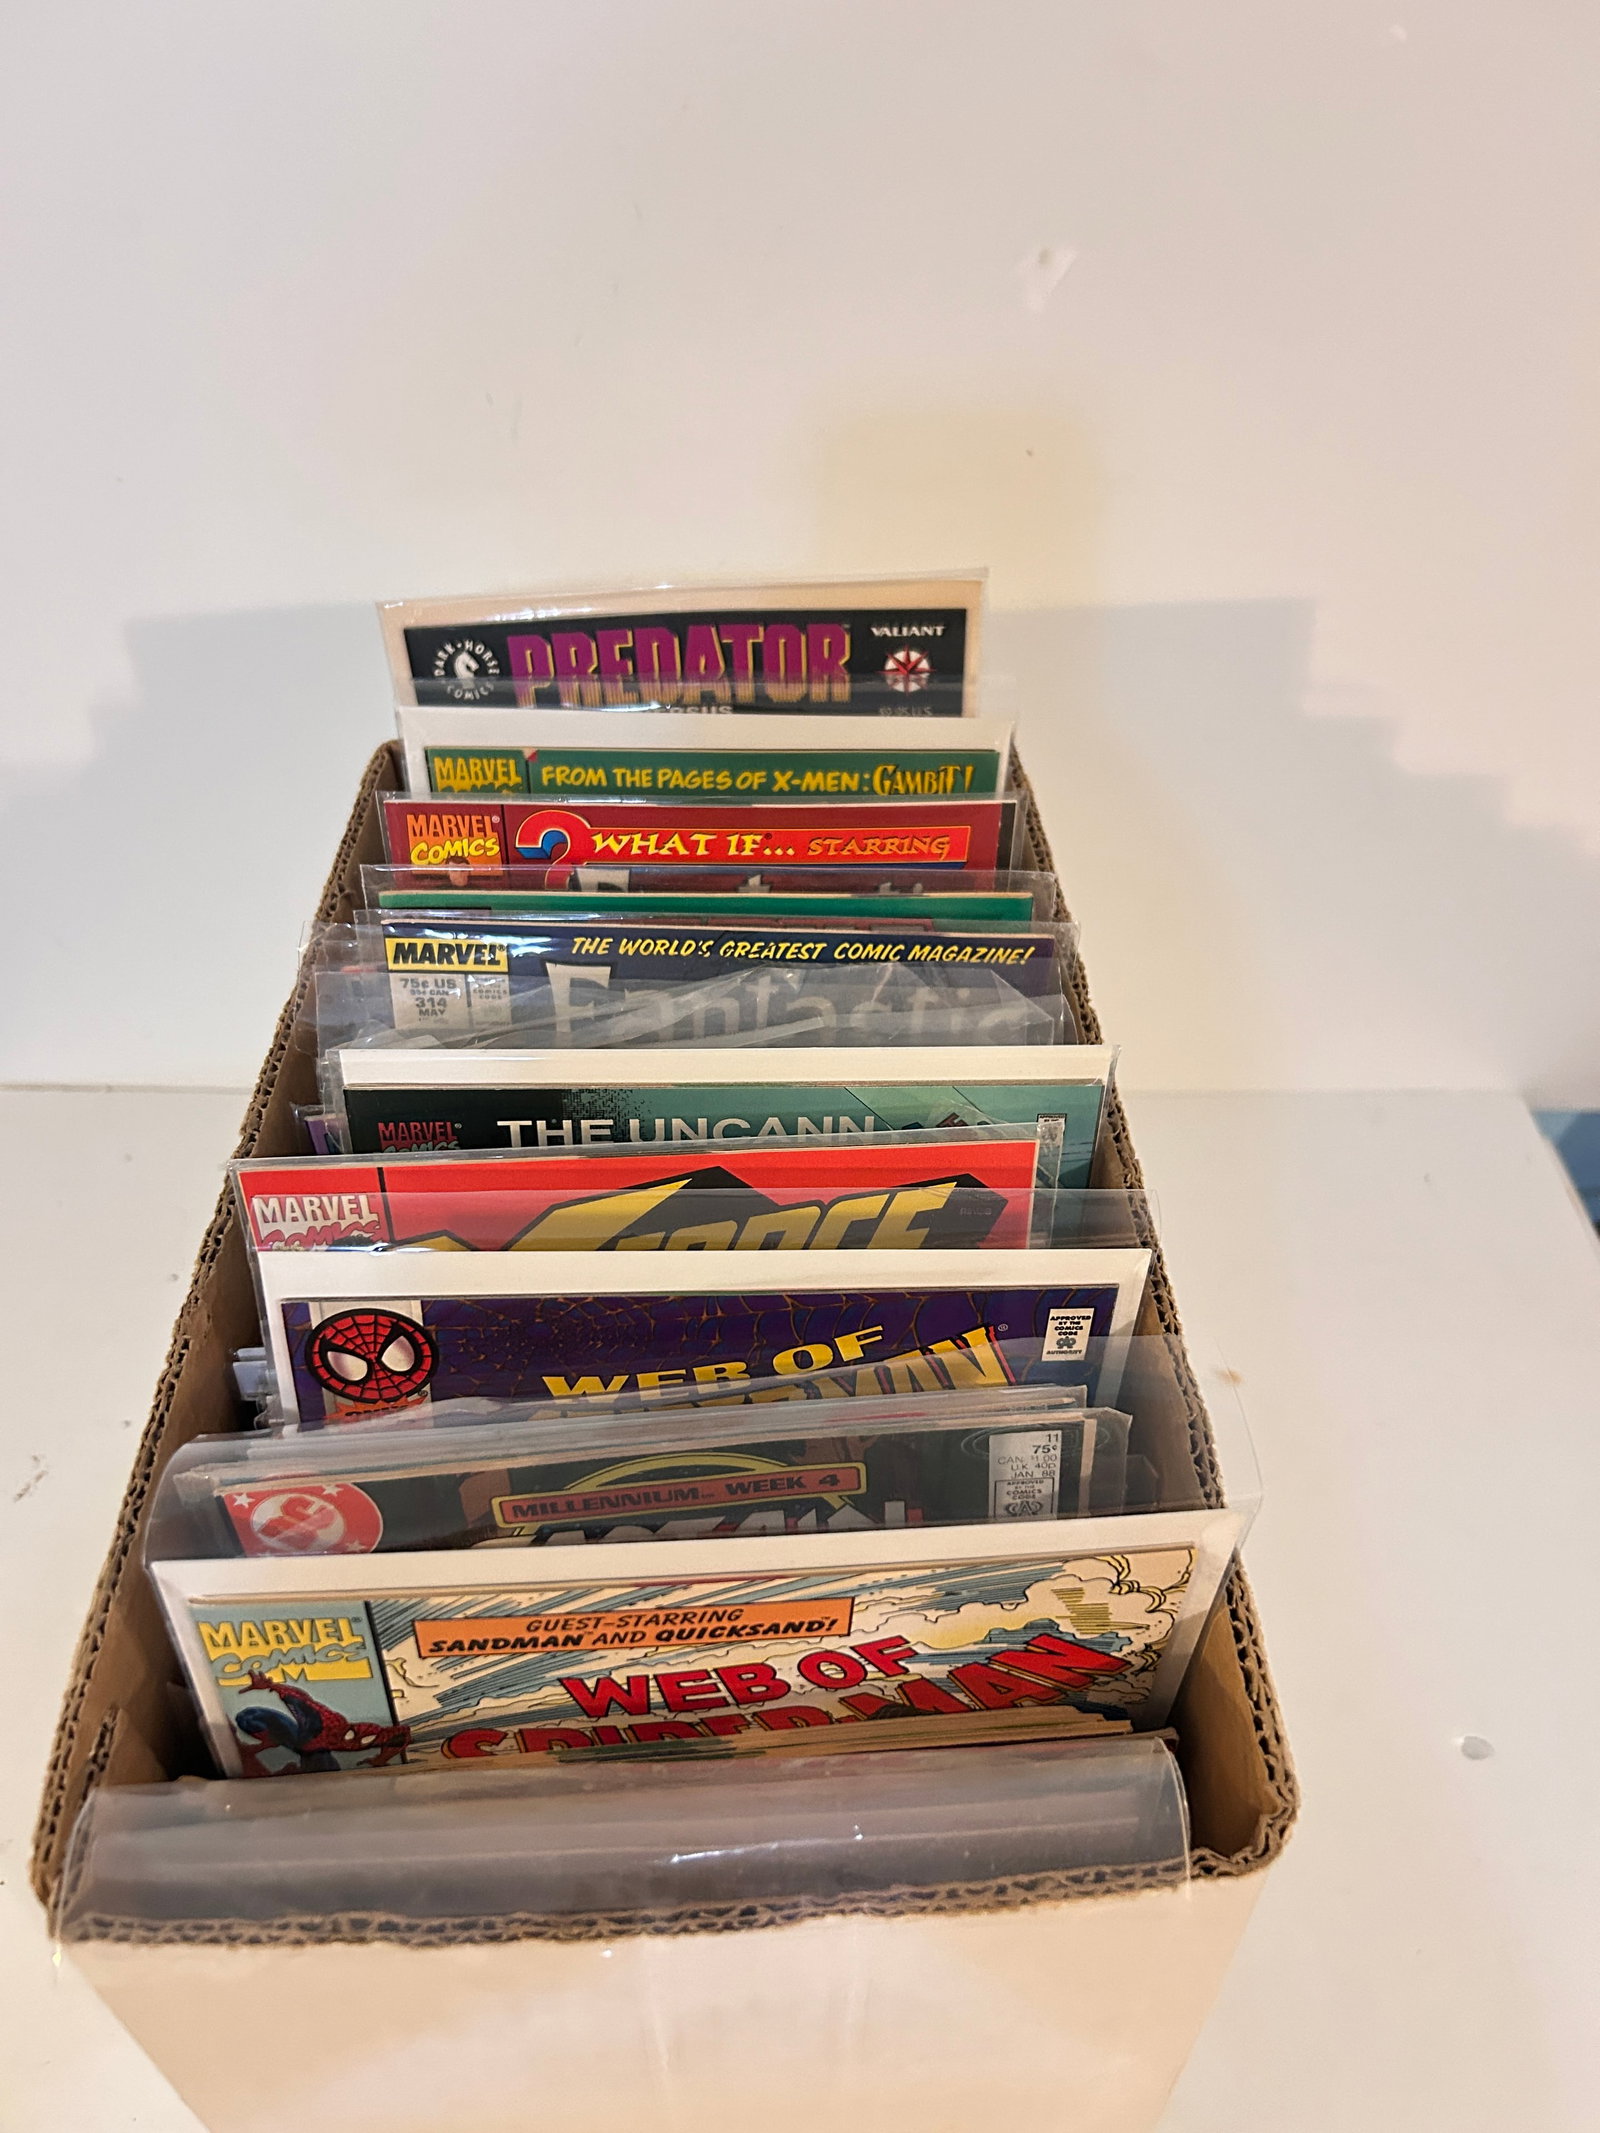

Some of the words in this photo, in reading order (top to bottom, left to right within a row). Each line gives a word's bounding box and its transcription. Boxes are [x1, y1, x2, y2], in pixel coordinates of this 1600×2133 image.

[870, 625, 946, 638] VALIANT
[465, 639, 500, 674] HORSE
[506, 623, 852, 709] PREDATOR
[433, 756, 523, 790] MARVEL
[541, 765, 608, 788] FROM
[612, 768, 653, 789] THE
[657, 769, 732, 790] PAGES
[736, 770, 767, 791] OF
[772, 770, 871, 793] X-MEN:
[406, 813, 499, 838] MARVEL
[410, 838, 500, 867] COMICS
[591, 832, 719, 857] WHAT
[807, 834, 951, 861] STARRING
[392, 942, 502, 967] MARVEL
[571, 936, 613, 955] THE
[617, 938, 714, 959] WORLD'S
[719, 940, 828, 961] GREATEST
[833, 942, 906, 963] COMIC
[908, 944, 1036, 966] MAGAZINE!
[434, 978, 458, 990] US
[415, 997, 449, 1009] 314
[418, 1008, 447, 1018] MAY
[378, 1121, 459, 1143] MARVEL
[497, 1118, 614, 1147] THE
[251, 1193, 380, 1226] MARVEL
[541, 1360, 750, 1405] WEB
[772, 1325, 884, 1377] OF
[1046, 1433, 1059, 1443] 11
[997, 1456, 1024, 1465] CAN
[725, 1475, 807, 1497] WEEK
[818, 1473, 841, 1488] 4
[1011, 1471, 1034, 1479] JAN
[197, 1616, 366, 1649] MARVEL
[525, 1607, 745, 1633] GUEST-STARRING
[428, 1633, 584, 1654] SANDMAN
[592, 1628, 647, 1646] AND
[655, 1617, 839, 1643] QUICKSAND!
[210, 1641, 371, 1680] COMICS
[559, 1660, 791, 1719] WEB
[798, 1635, 920, 1691] OF
